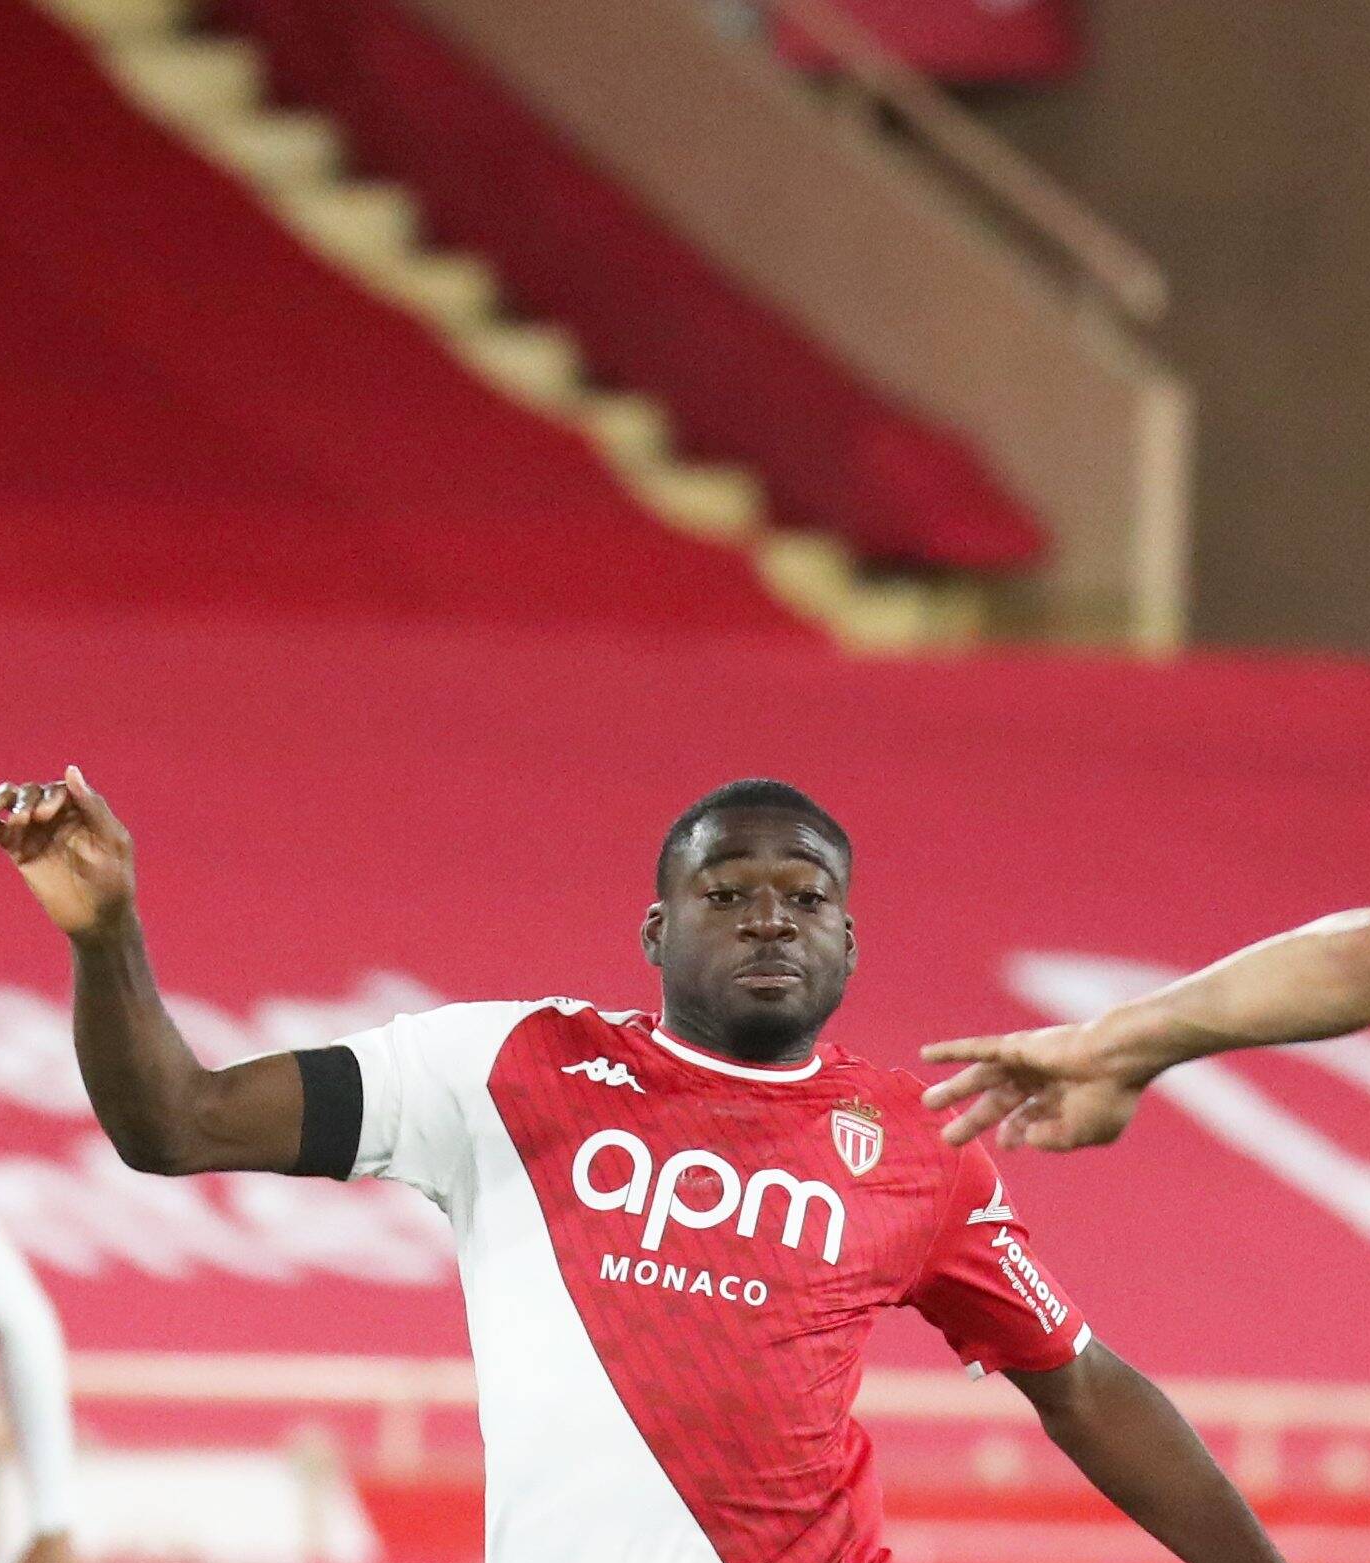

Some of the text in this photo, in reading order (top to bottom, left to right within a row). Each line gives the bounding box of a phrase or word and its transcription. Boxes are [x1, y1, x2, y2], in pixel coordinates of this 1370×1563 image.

[571, 1129, 846, 1266] apm
[598, 1254, 769, 1307] MONACO
[991, 1226, 1068, 1326] yomoni
[1025, 1295, 1037, 1309] en
[1035, 1306, 1054, 1335] mieux
